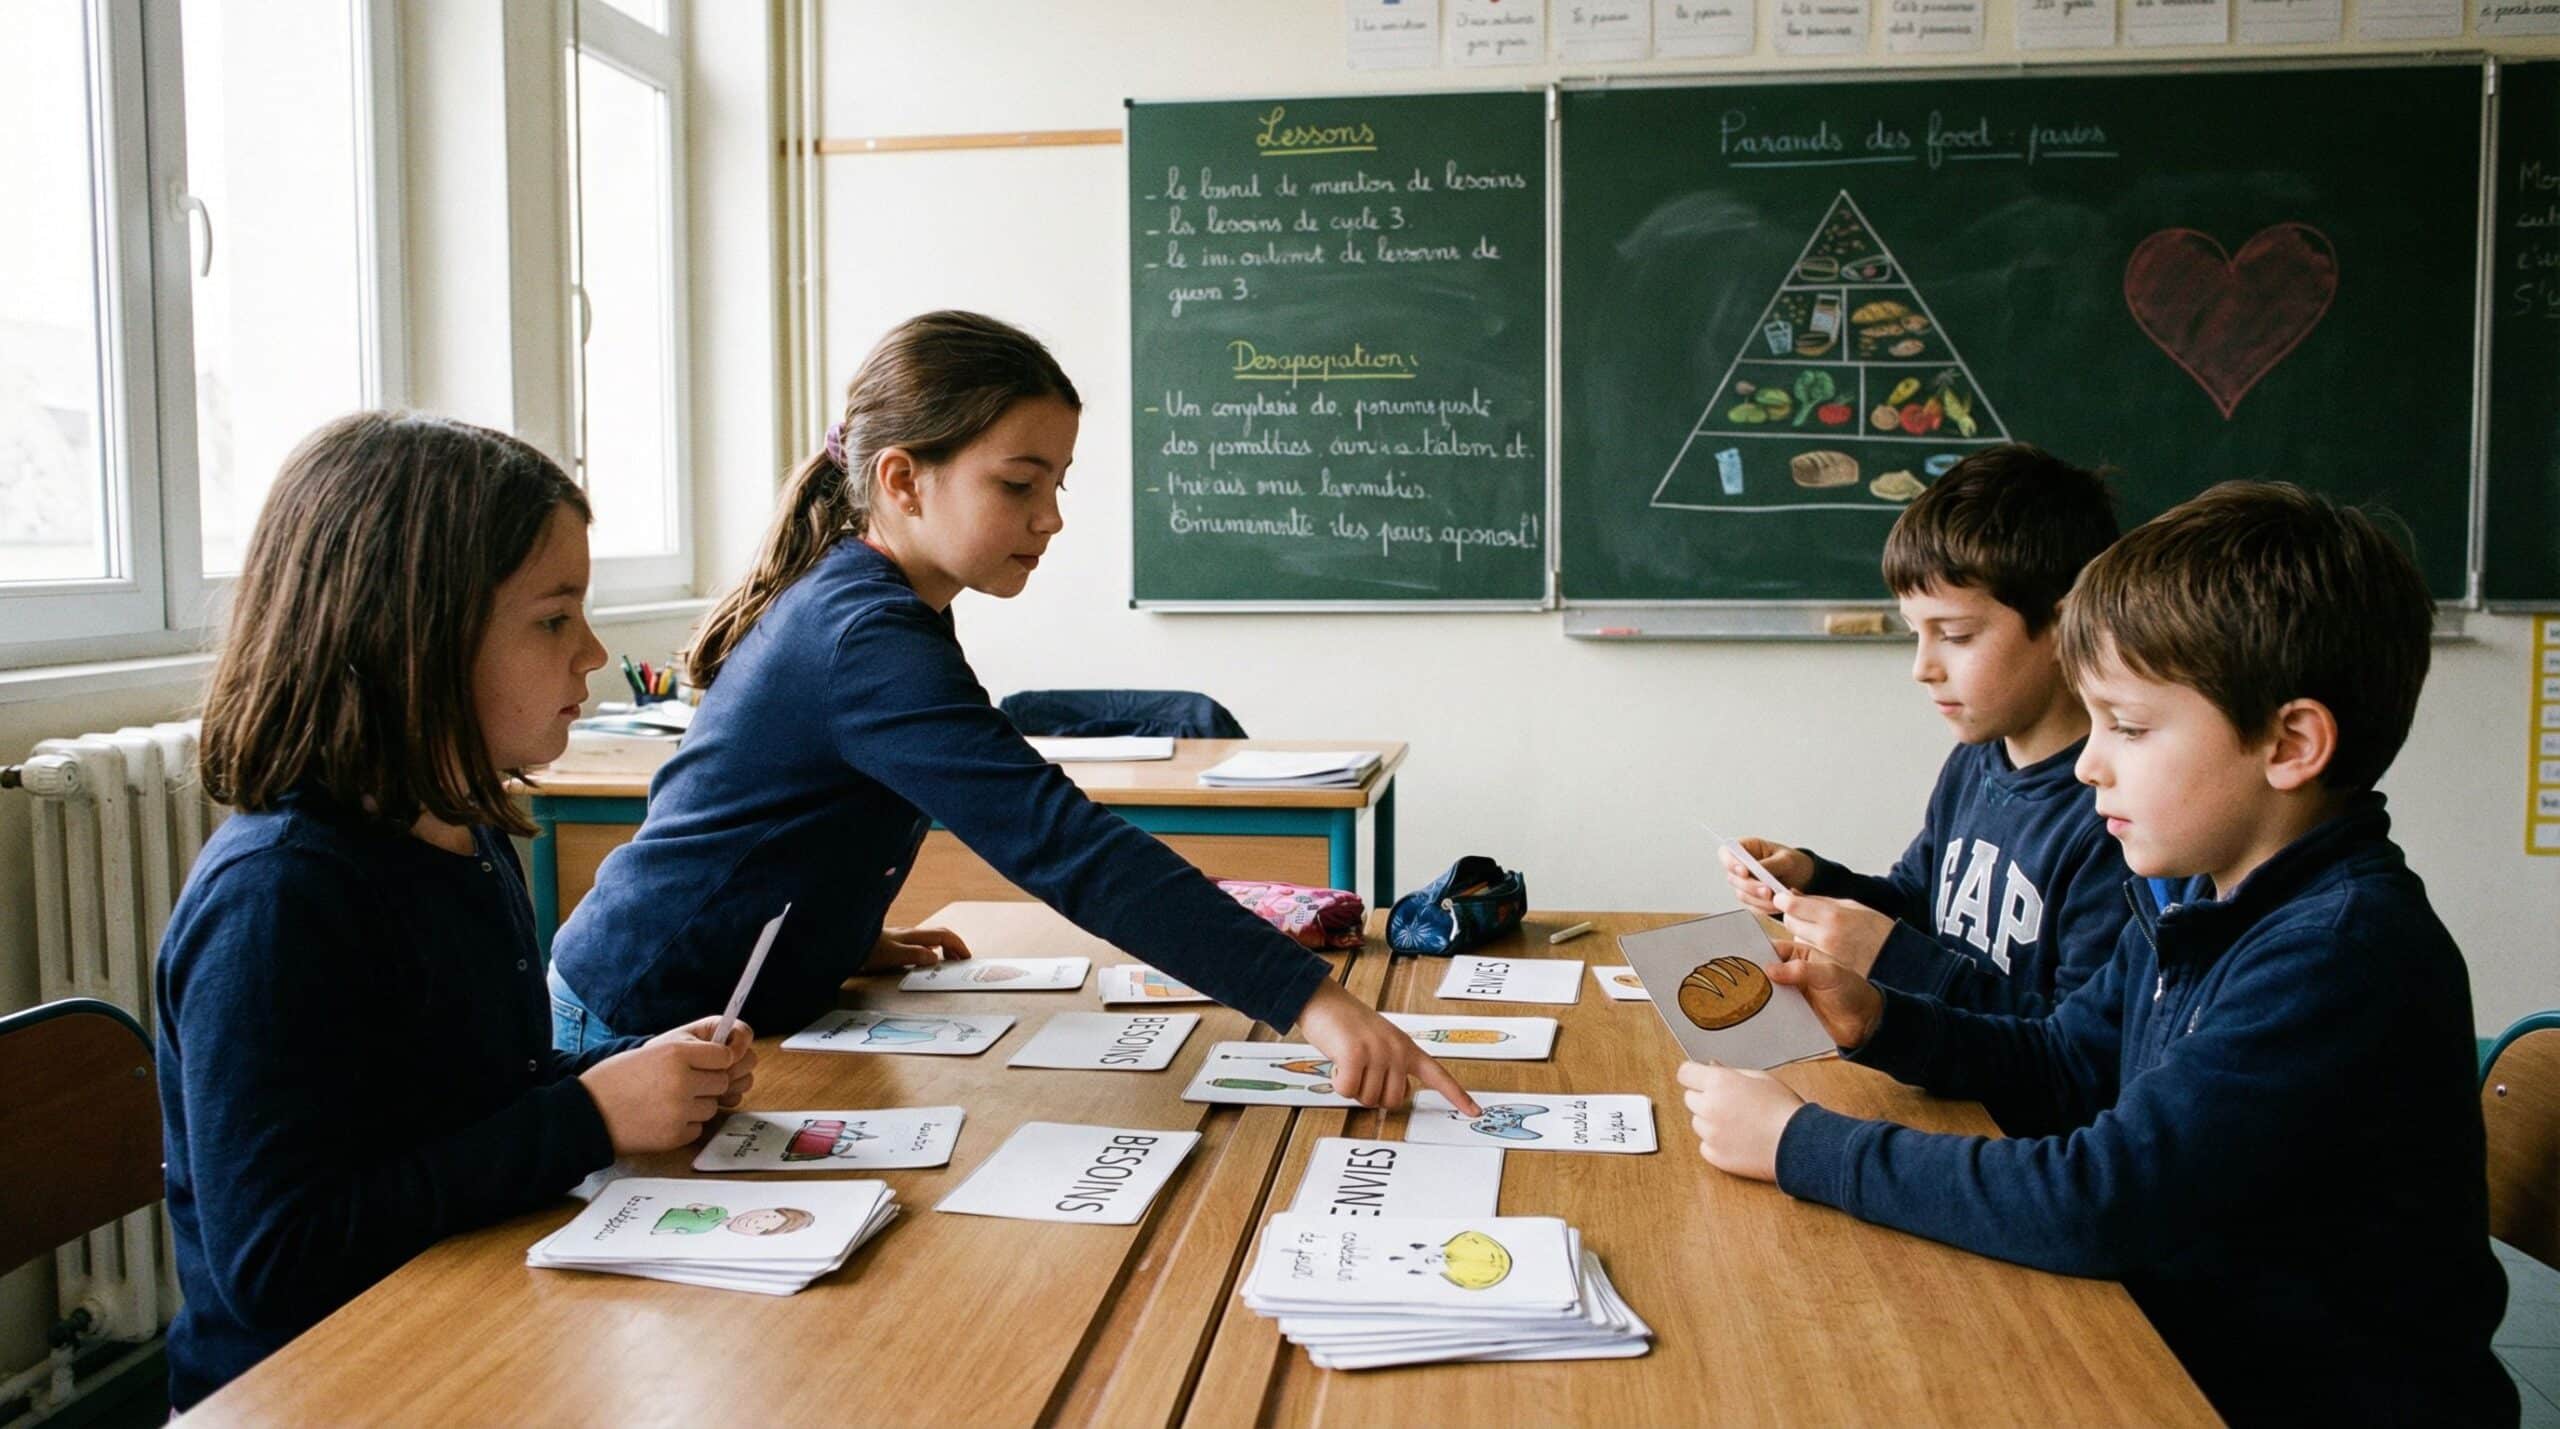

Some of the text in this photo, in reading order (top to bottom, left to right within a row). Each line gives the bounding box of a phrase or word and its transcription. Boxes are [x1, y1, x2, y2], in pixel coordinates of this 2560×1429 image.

[1256, 105, 1376, 147] Lessons
[1864, 119, 1911, 150] des
[1926, 109, 1993, 169] food
[1407, 167, 1434, 192] de
[1293, 209, 1319, 232] de
[1339, 240, 1367, 264] de
[1472, 235, 1501, 259] de
[1162, 430, 1199, 456] des
[1935, 837, 2044, 976] GAP
[1466, 961, 1511, 995] ENVIES
[1100, 1016, 1169, 1066] BESOINS
[1055, 1134, 1160, 1214] BESOINS
